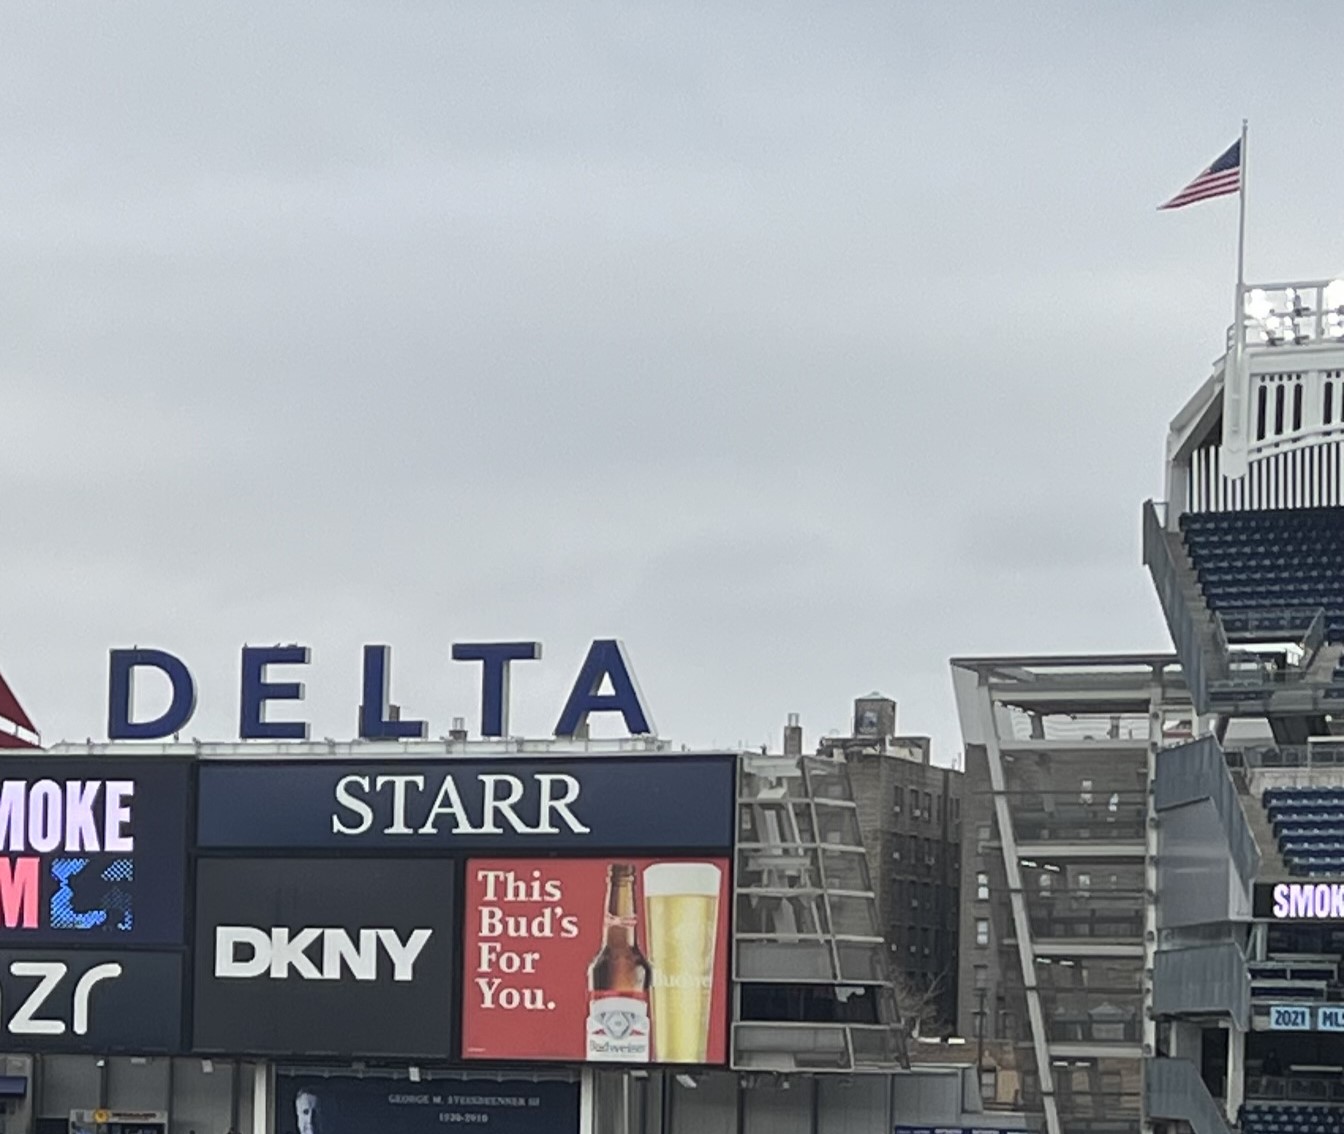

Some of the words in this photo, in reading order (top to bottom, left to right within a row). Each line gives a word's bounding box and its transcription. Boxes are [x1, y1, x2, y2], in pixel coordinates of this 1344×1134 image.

[107, 638, 658, 741] DELTA
[331, 772, 591, 835] STARR
[477, 869, 562, 902] This
[213, 925, 434, 982] DKNY
[477, 944, 541, 975] For
[474, 977, 557, 1011] You.
[1274, 1009, 1306, 1026] 2021
